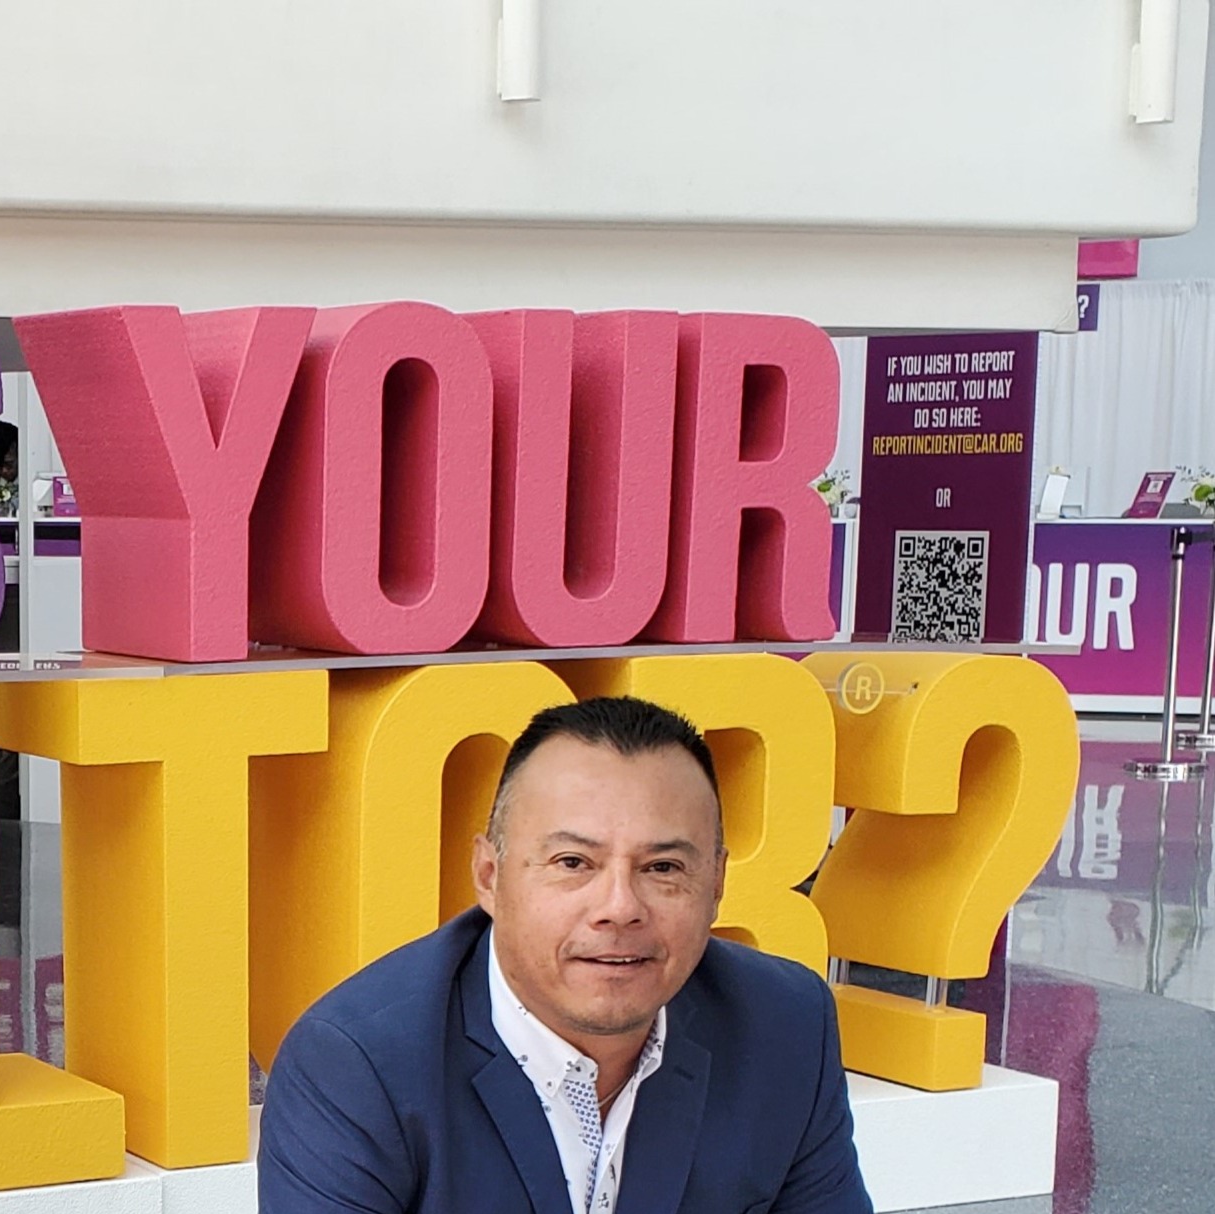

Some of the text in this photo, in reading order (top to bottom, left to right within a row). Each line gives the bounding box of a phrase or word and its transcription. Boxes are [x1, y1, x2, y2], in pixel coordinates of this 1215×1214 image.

[887, 350, 1016, 377] IF YOU WISH TO REPORT
[887, 378, 1013, 403] AN INCIDENT, YOU MAY
[913, 406, 982, 428] DO SO HERE:
[872, 432, 1024, 455] REPORTINCIDENT@CAR.ORG
[13, 301, 841, 663] YOUR
[935, 487, 952, 508] OR
